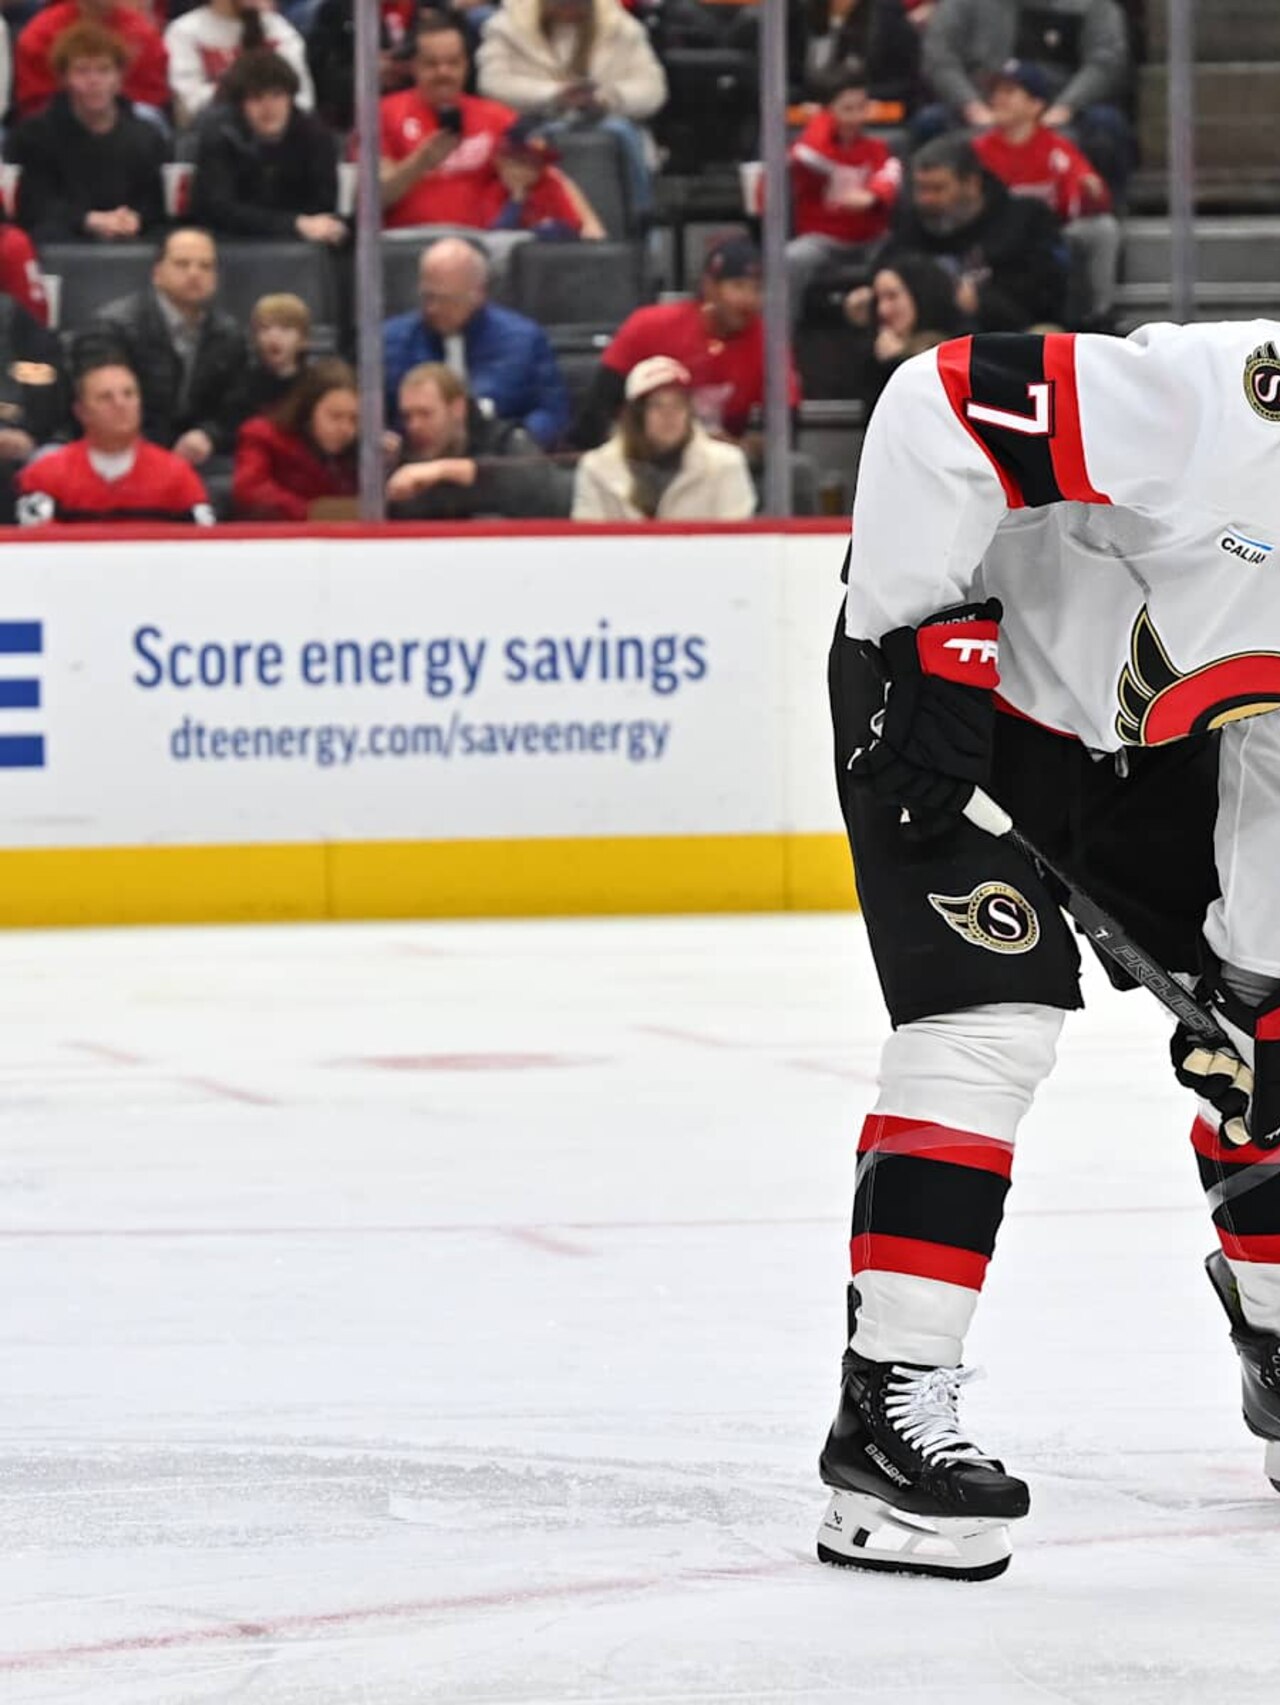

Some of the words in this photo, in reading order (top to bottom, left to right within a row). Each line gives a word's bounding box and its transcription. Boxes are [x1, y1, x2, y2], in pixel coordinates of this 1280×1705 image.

[965, 381, 1053, 435] 7
[133, 624, 284, 689] Score
[300, 635, 486, 697] energy
[504, 619, 708, 696] savings
[942, 637, 998, 664] TR
[170, 711, 672, 768] dteenergy.com/saveenergy
